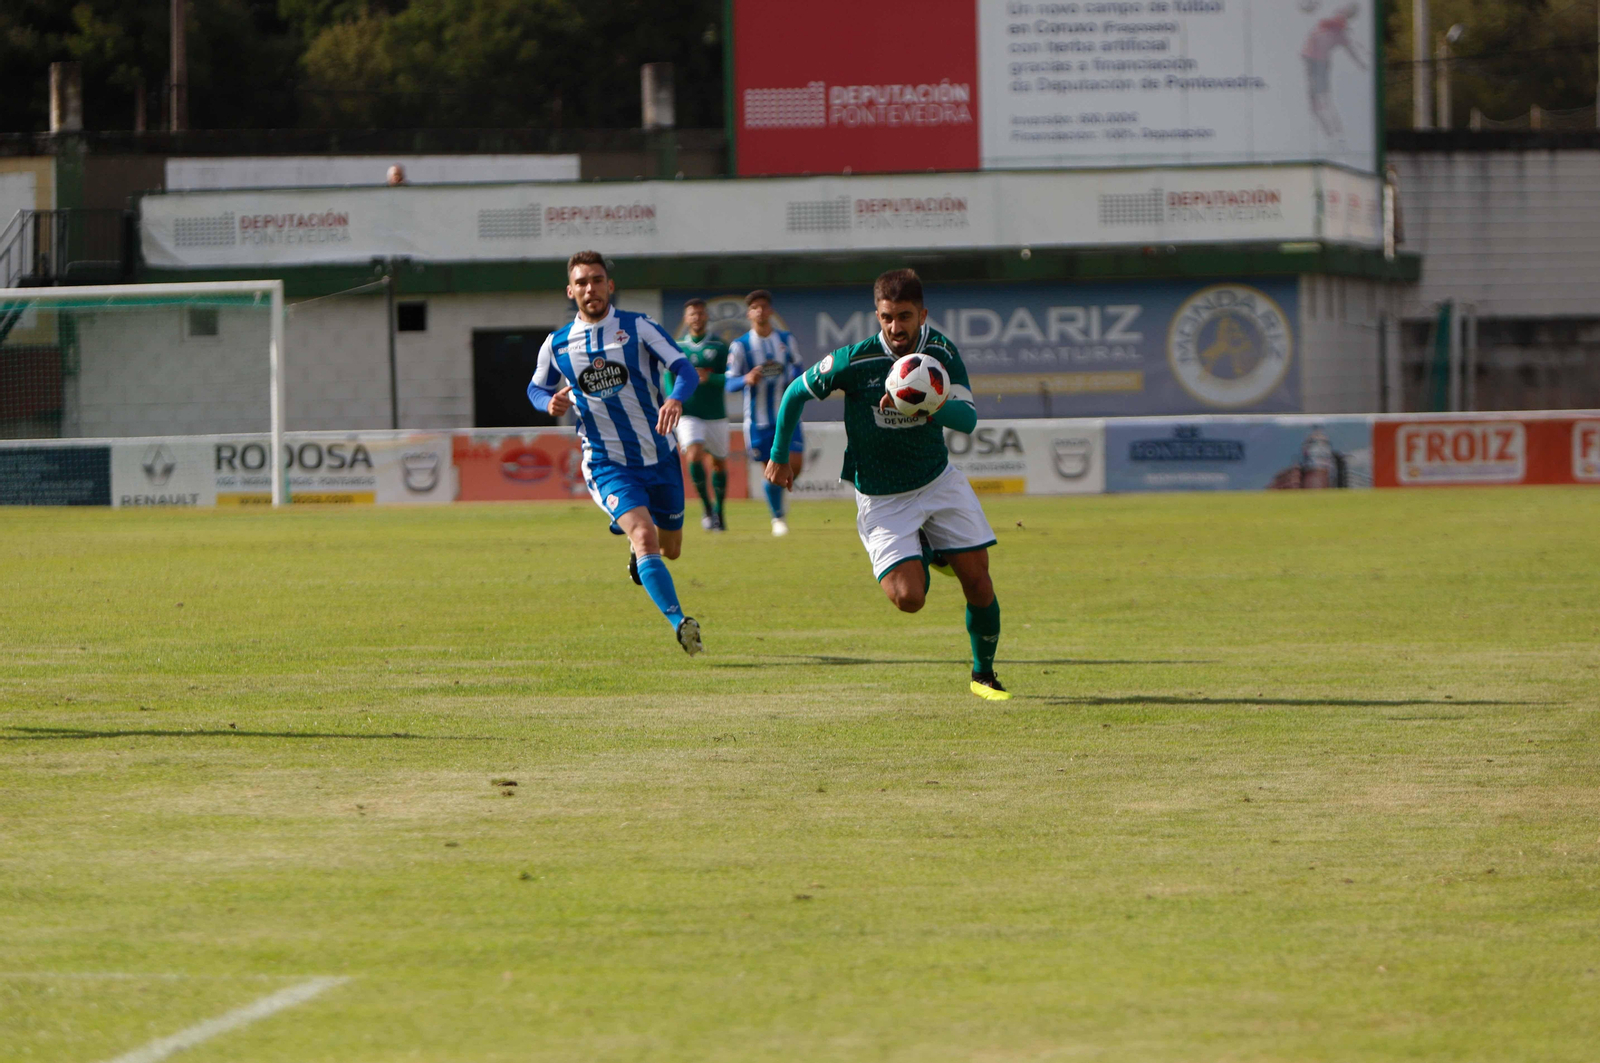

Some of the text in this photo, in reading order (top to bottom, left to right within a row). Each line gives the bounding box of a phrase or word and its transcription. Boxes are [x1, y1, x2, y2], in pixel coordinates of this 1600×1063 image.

[1085, 3, 1143, 16] campo
[1149, 2, 1168, 12] de
[1008, 42, 1041, 53] con
[1100, 38, 1169, 51] artificial
[829, 79, 970, 104] DEPUTACIÓN
[1140, 79, 1160, 89] de
[829, 104, 973, 127] PONTEVEDRA
[855, 192, 968, 214] DEPUTACIÓN
[1167, 184, 1281, 206] DEPUTACIÓN
[240, 208, 349, 229] DEPUTACIÓN
[545, 200, 656, 222] DEPUTACIÓN
[816, 303, 1144, 349] MNDARIZ
[1018, 345, 1144, 366] NATURAL
[583, 366, 622, 384] Estrella
[587, 376, 623, 392] Galicia
[884, 416, 919, 425] DE VIGO
[1405, 430, 1517, 462] FROIZ
[121, 493, 199, 506] RENAULT
